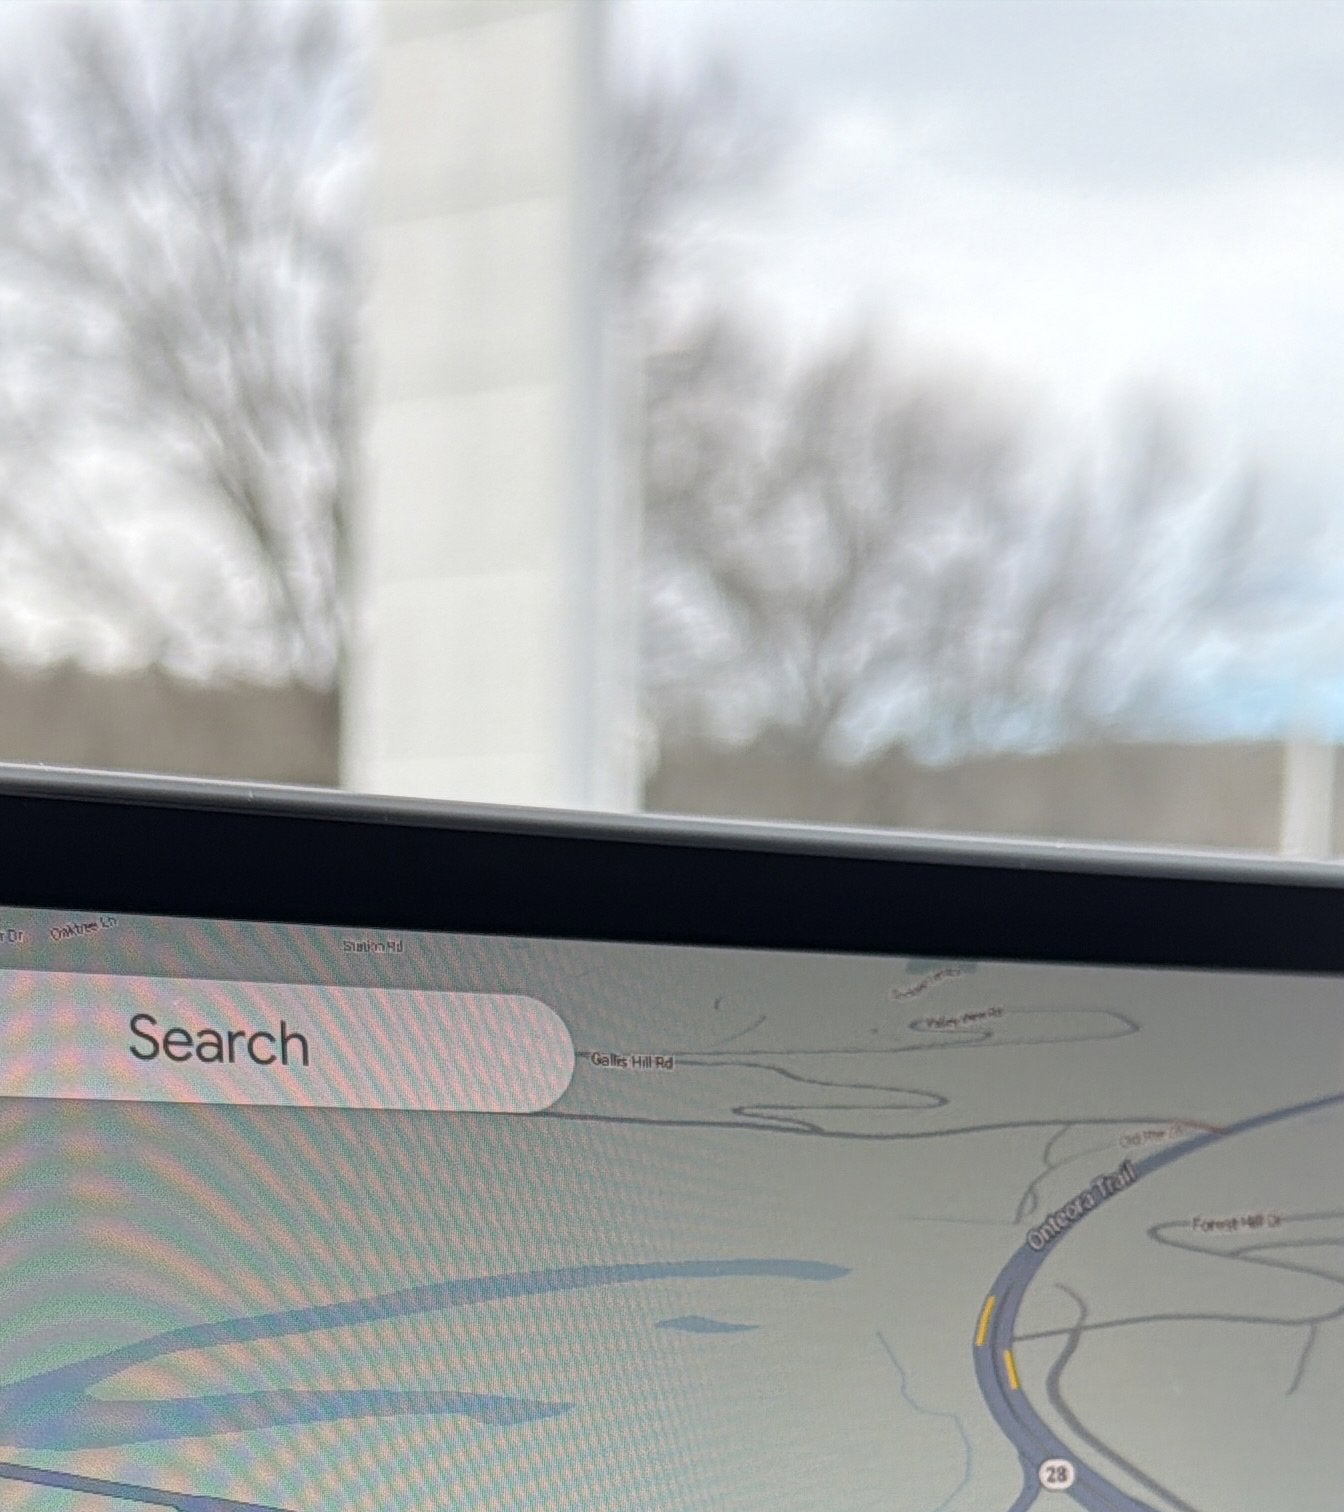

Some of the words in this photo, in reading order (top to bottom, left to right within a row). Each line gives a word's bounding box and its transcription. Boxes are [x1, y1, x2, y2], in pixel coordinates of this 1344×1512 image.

[129, 1013, 310, 1067] Search
[632, 1055, 652, 1070] Hill
[655, 1055, 674, 1070] Rd
[1094, 1159, 1137, 1200] Trail
[1046, 1465, 1067, 1483] 28
